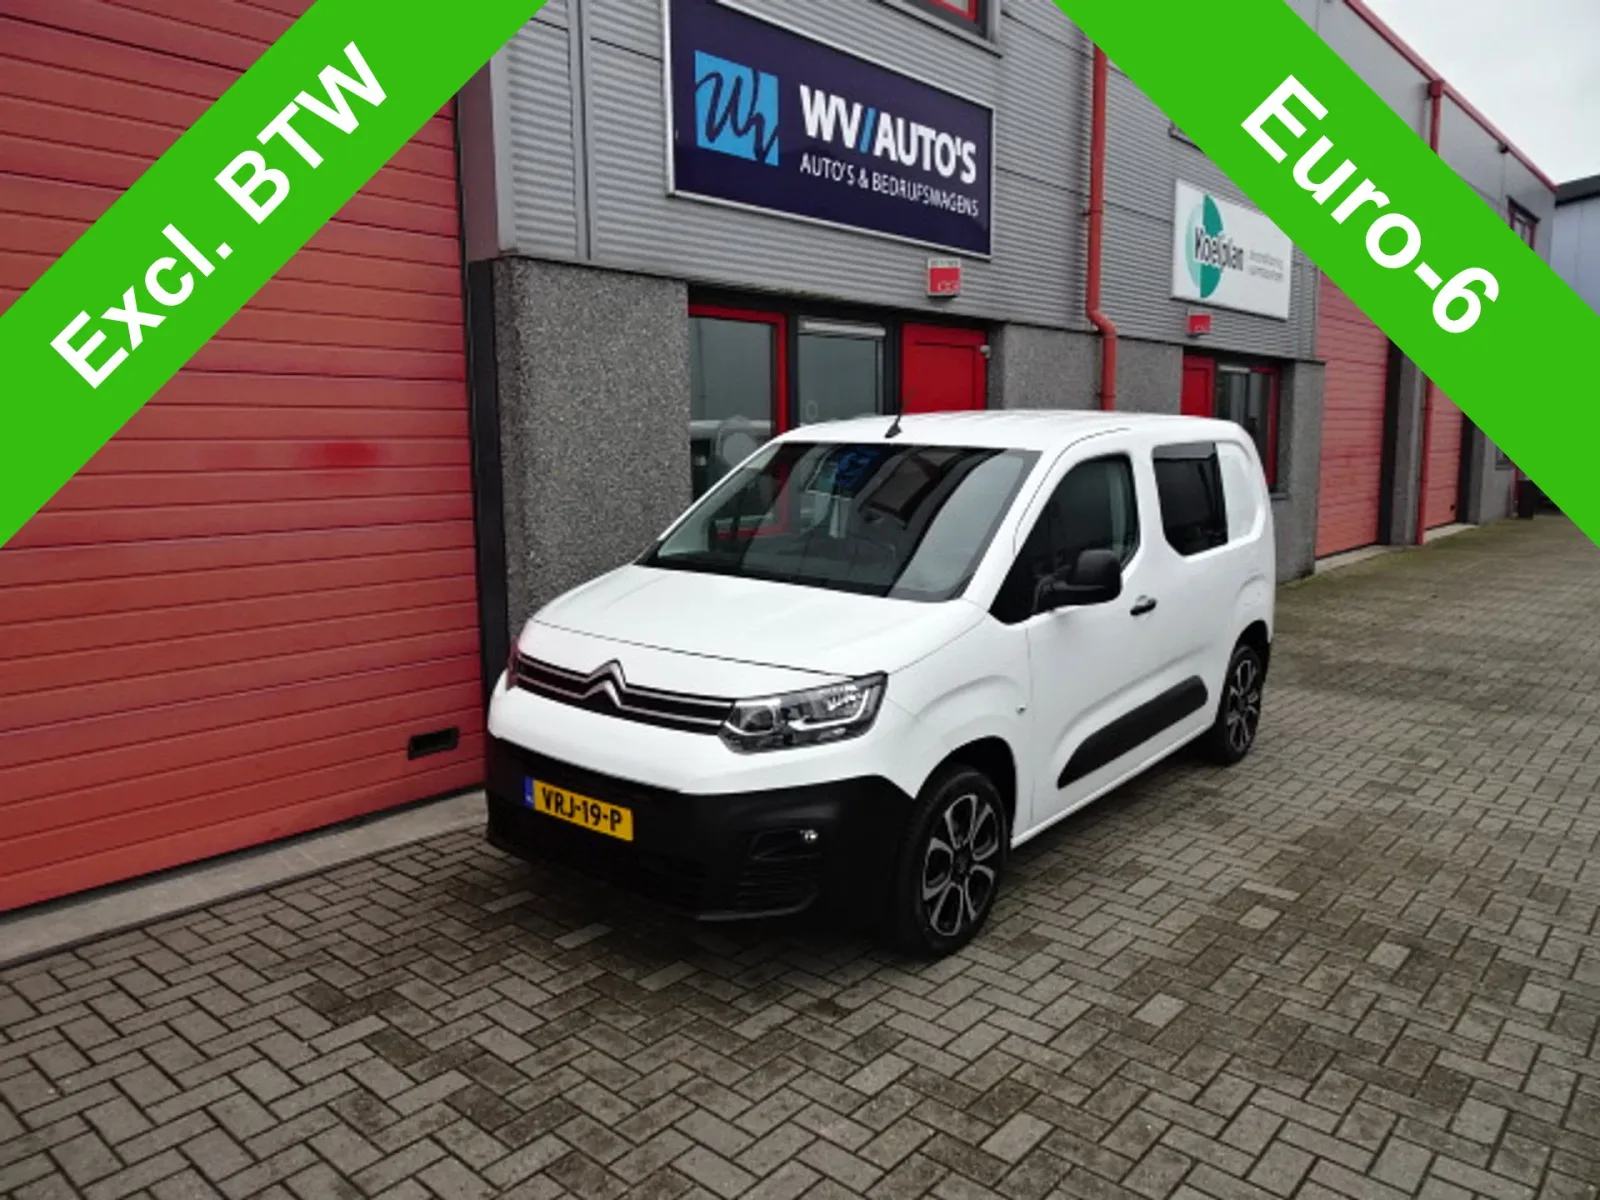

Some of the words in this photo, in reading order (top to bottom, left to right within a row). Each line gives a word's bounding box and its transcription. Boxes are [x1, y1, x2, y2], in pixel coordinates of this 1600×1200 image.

[799, 152, 855, 187] AUTO'S
[857, 168, 869, 190] &
[541, 786, 623, 833] VRJ-19-P
